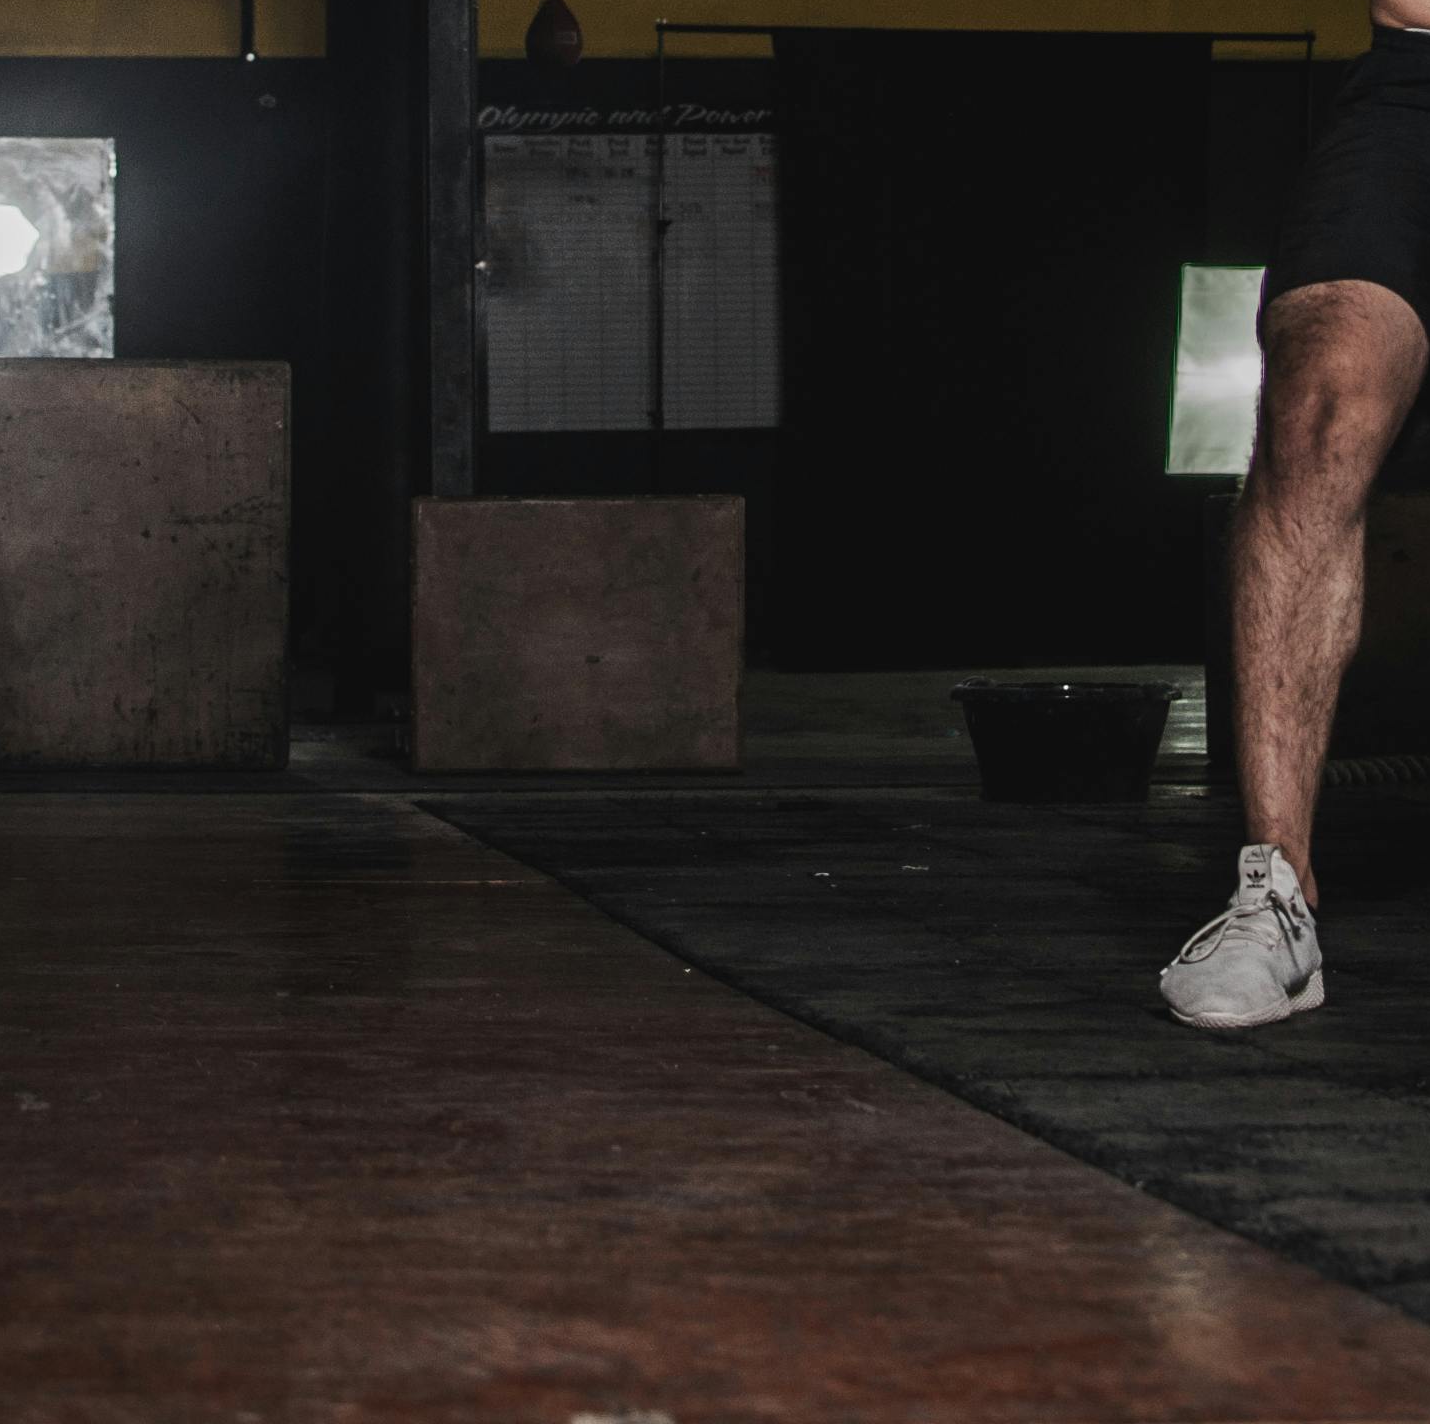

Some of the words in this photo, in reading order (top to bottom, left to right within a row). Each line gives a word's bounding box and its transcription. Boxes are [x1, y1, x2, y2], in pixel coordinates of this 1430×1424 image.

[476, 104, 602, 132] Olympic
[607, 104, 672, 125] and
[673, 103, 773, 126] Power
